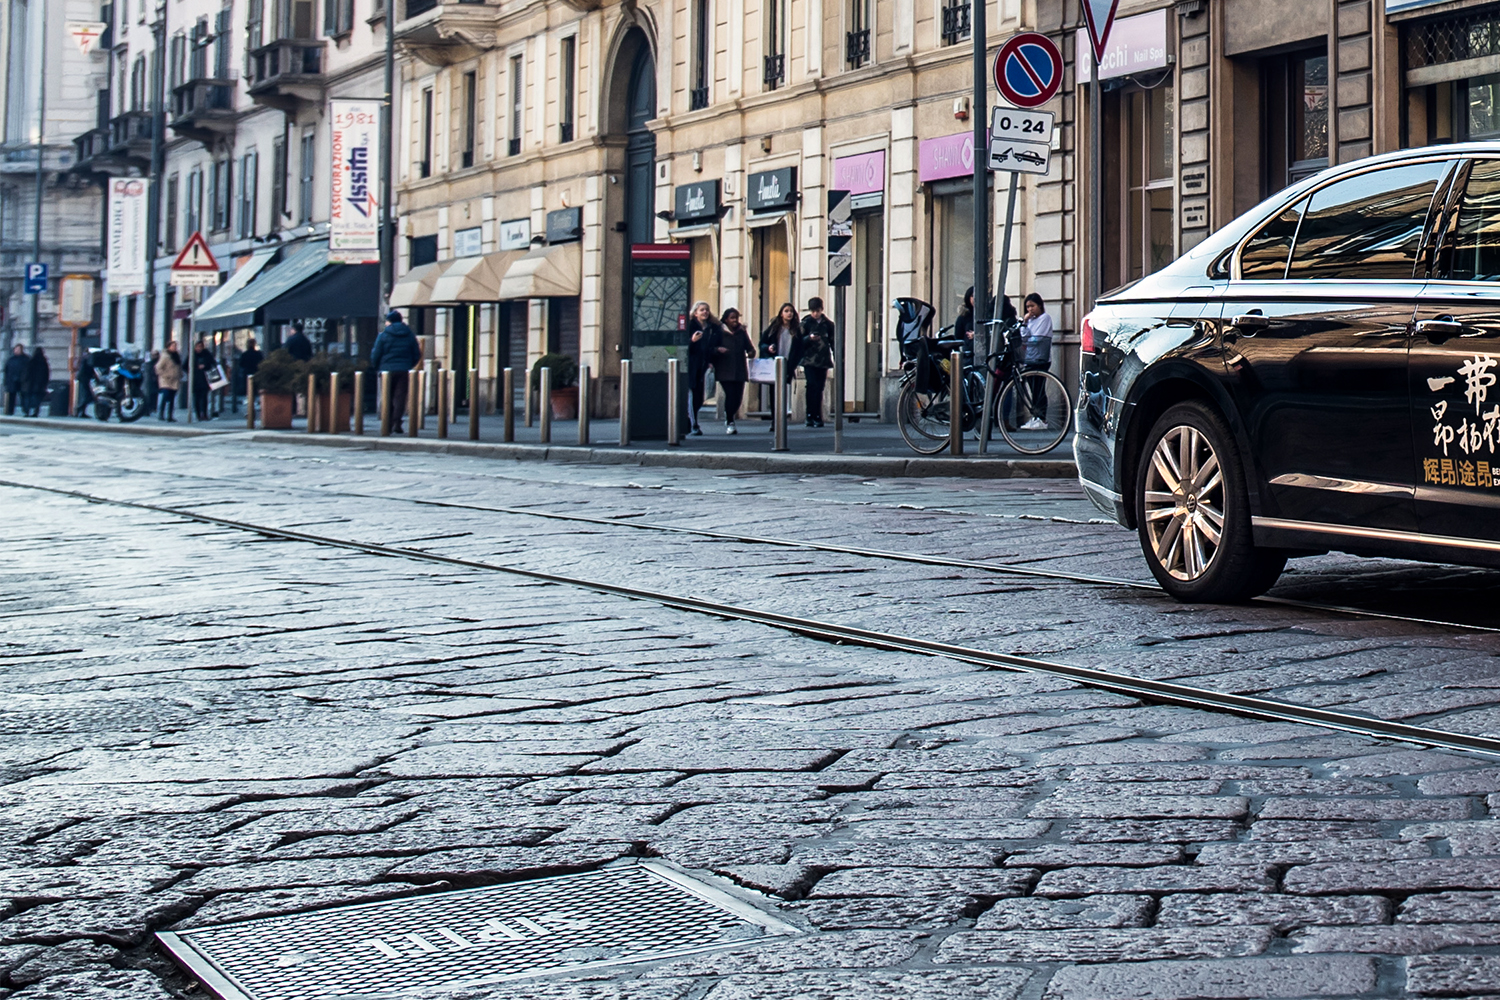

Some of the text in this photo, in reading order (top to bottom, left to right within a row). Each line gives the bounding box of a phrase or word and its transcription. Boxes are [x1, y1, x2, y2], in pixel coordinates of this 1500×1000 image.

[1082, 44, 1164, 74] Ccchi Nail Spa
[335, 112, 376, 129] 1981
[999, 117, 1012, 130] 0
[1022, 119, 1045, 134] 24
[332, 130, 343, 219] ASSICURAZIONI
[29, 264, 44, 280] P
